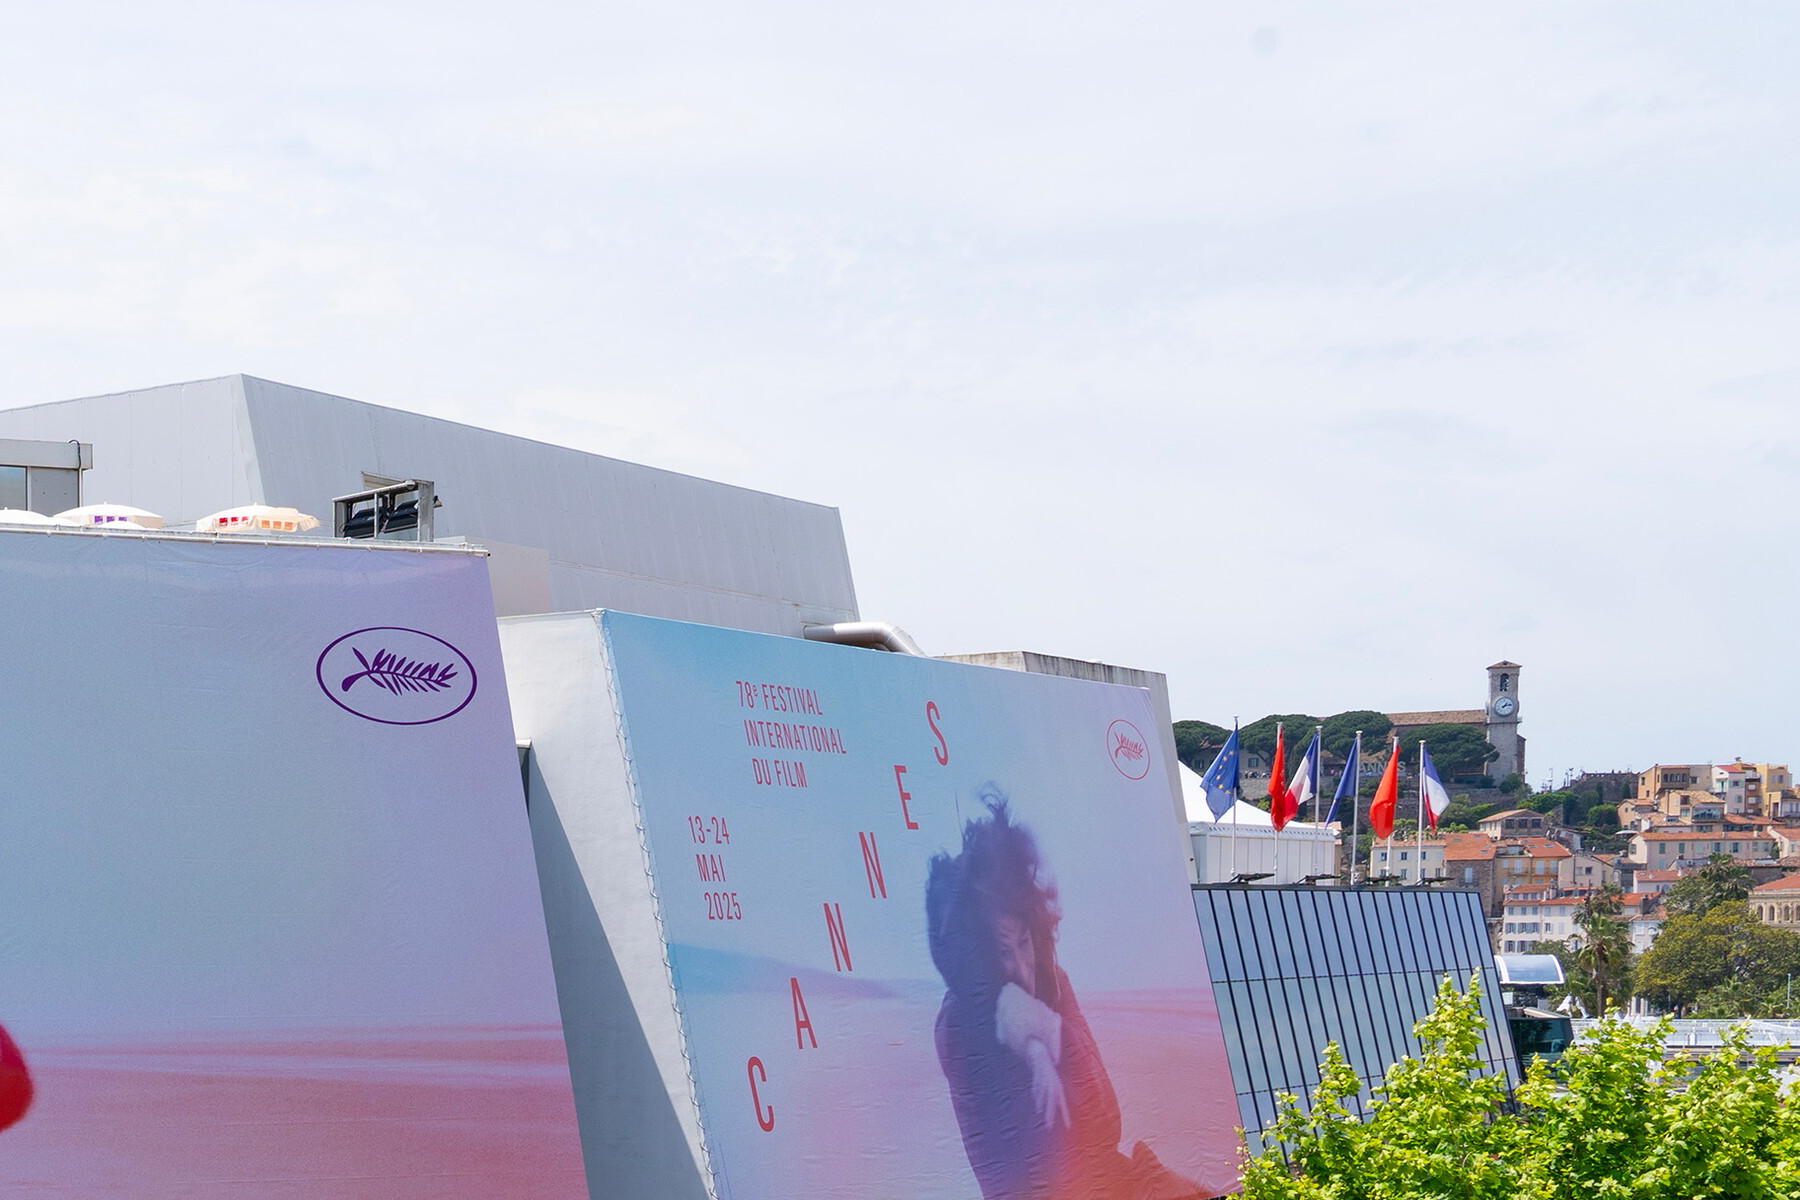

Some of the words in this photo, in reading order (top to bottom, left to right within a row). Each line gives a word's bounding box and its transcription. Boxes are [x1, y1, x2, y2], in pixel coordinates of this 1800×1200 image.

[761, 684, 823, 716] FESTIVAL
[744, 720, 847, 754] INTERNATIONAL
[752, 758, 773, 786] DU
[774, 759, 808, 788] FILM
[687, 815, 730, 845] 13-24
[695, 853, 726, 882] MAI
[704, 891, 742, 921] 2025
